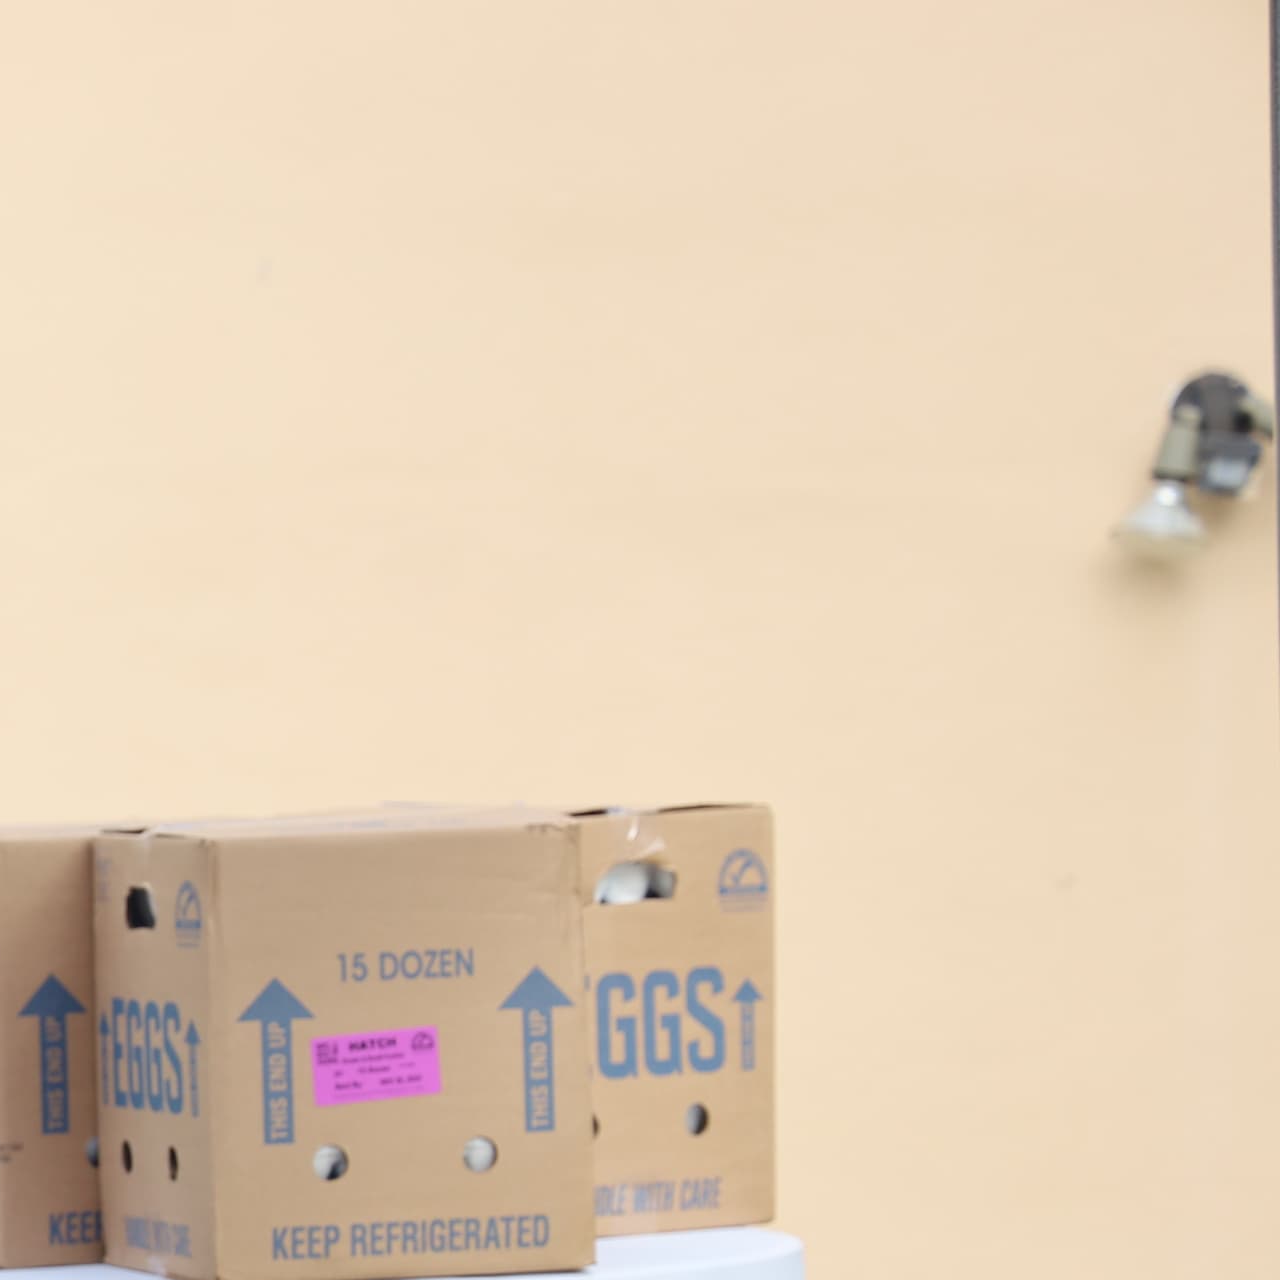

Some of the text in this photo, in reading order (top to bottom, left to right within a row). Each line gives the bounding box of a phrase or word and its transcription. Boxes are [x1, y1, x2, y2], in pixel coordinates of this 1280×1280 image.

[336, 947, 476, 983] 15 DOZEN
[111, 996, 184, 1115] EGGS
[584, 965, 726, 1080] GGS
[271, 1214, 551, 1262] KEEP REFRIGERATED
